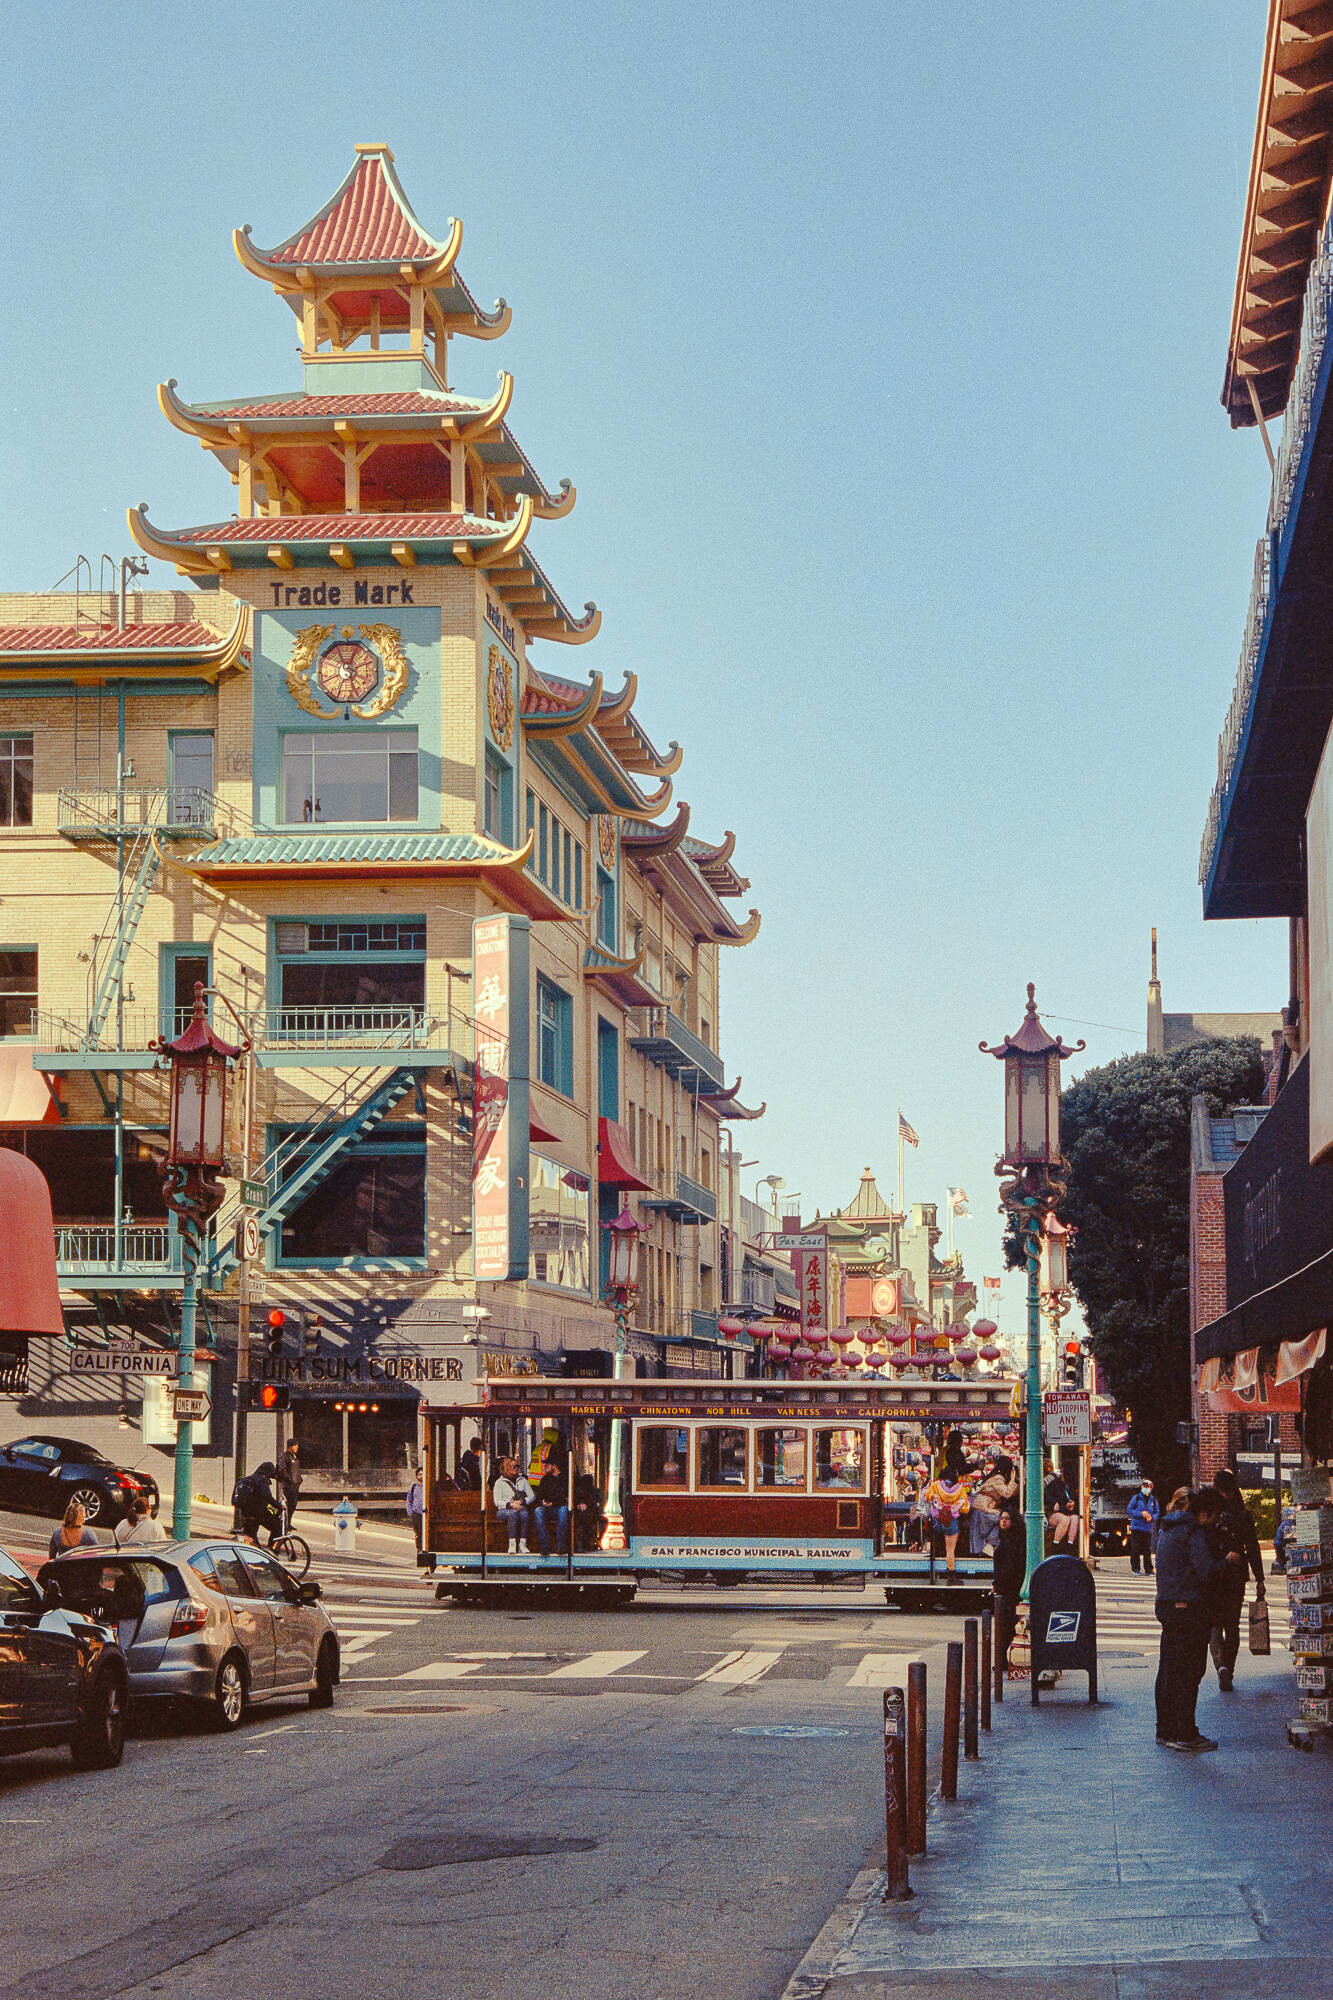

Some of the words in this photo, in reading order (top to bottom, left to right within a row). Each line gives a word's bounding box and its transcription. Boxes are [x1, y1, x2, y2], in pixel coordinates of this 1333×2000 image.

[269, 581, 341, 606] Trade
[354, 579, 415, 605] Mark
[245, 1186, 264, 1204] Grant
[475, 1230, 507, 1244] RESTAURANT
[777, 1235, 795, 1246] Far
[799, 1235, 823, 1246] East
[119, 1341, 135, 1350] 700
[74, 1354, 172, 1372] CALIFORNIA
[311, 1357, 360, 1379] SUM
[369, 1356, 464, 1381] CORNER
[177, 1399, 189, 1411] ONE
[191, 1400, 201, 1412] WAY
[571, 1406, 606, 1414] MARKET
[640, 1407, 691, 1415] CHINATOWN
[1046, 1402, 1058, 1413] NO
[1059, 1403, 1088, 1413] STOPPING
[777, 1408, 795, 1416] VAN
[797, 1408, 820, 1416] NESS
[1059, 1416, 1077, 1425] ANY
[1058, 1426, 1079, 1435] TIME
[651, 1547, 674, 1556] SAN
[678, 1547, 741, 1556] FRANCISCO
[744, 1548, 803, 1557] MUNICIPAL
[807, 1549, 852, 1558] RAILWAY
